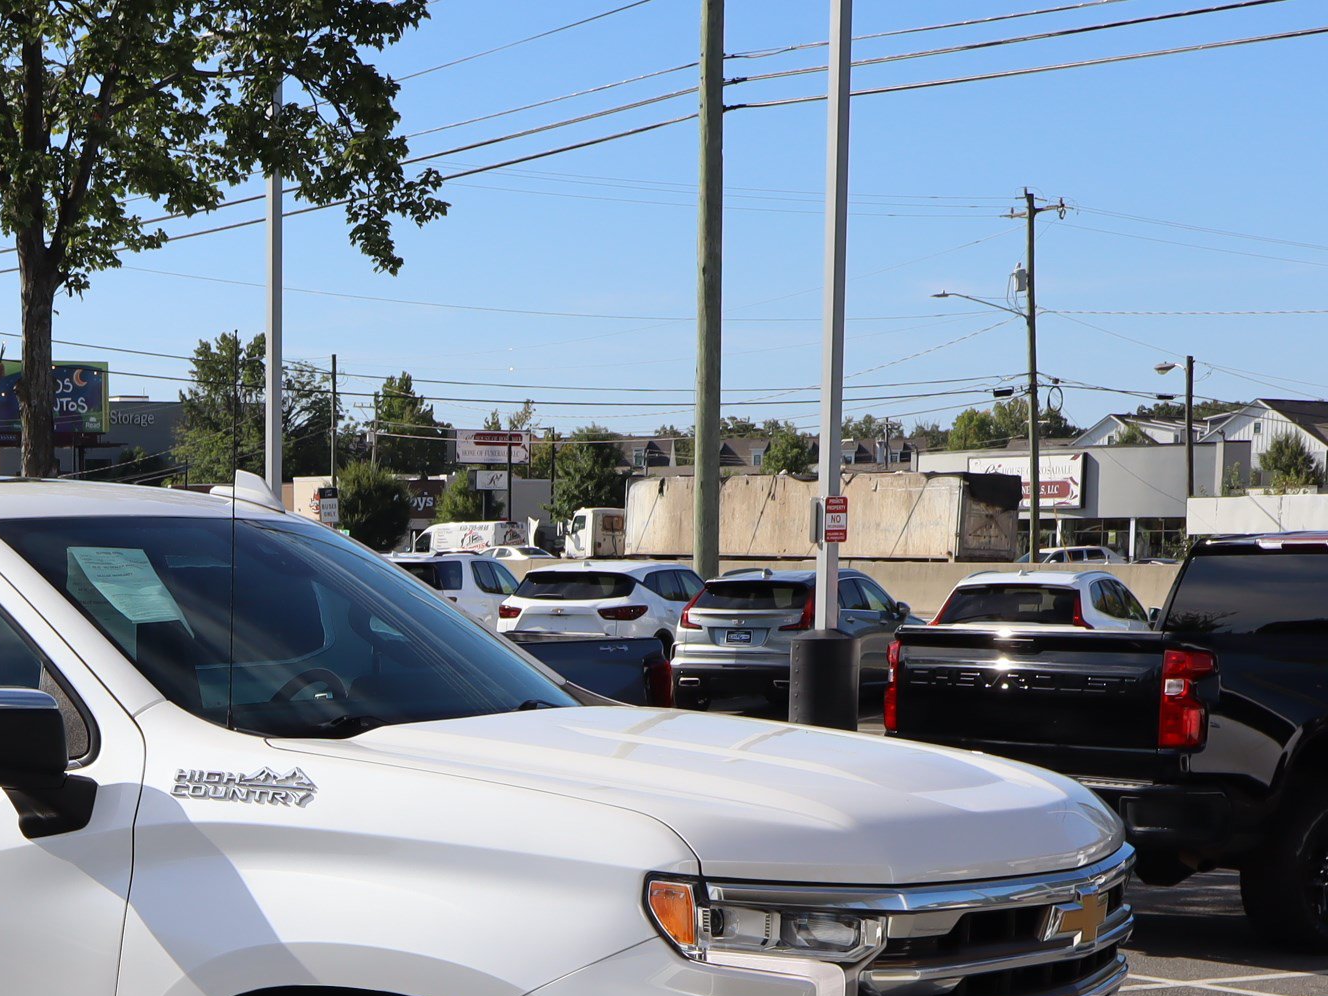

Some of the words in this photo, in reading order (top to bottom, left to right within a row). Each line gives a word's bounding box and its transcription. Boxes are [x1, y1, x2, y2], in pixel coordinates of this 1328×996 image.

[109, 409, 155, 427] Storage
[830, 514, 842, 524] NO
[173, 768, 245, 785] HIGH
[170, 783, 315, 808] COUNTRY
